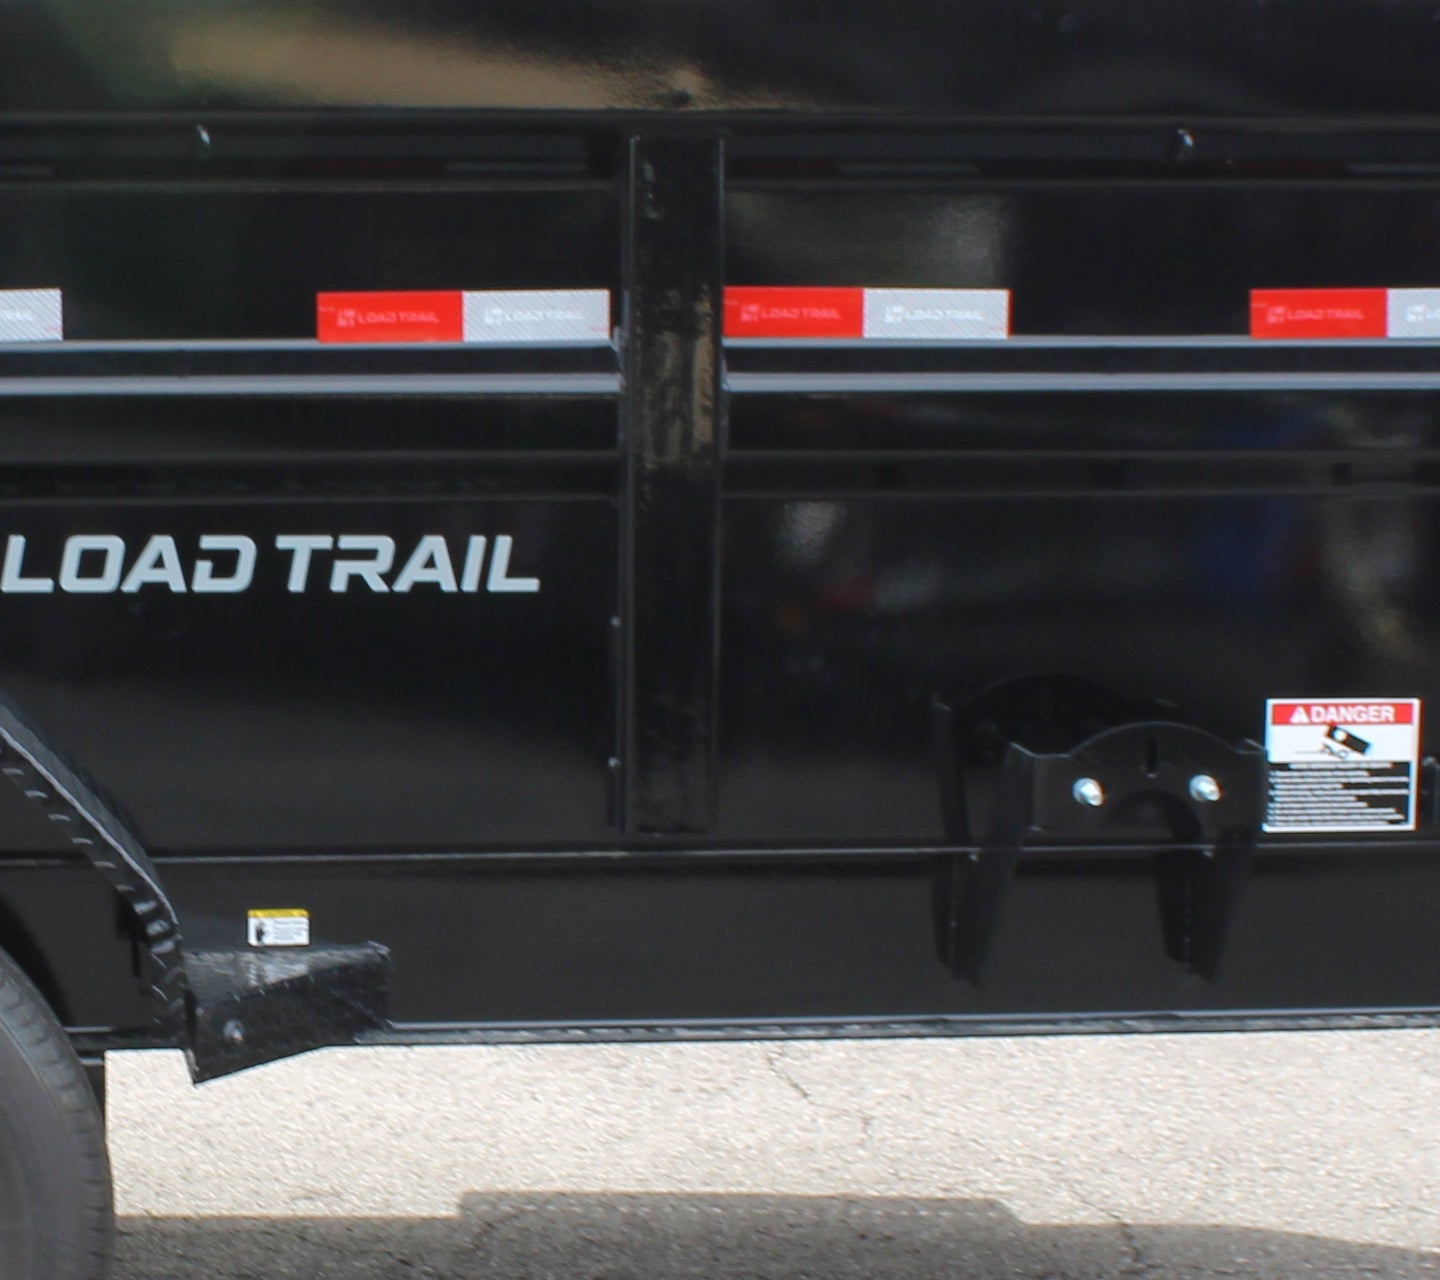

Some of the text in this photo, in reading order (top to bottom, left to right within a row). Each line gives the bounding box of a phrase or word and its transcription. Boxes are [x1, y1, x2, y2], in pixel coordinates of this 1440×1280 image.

[0, 534, 541, 593] LOAD TRAIL
[1310, 704, 1395, 723] DANGER
